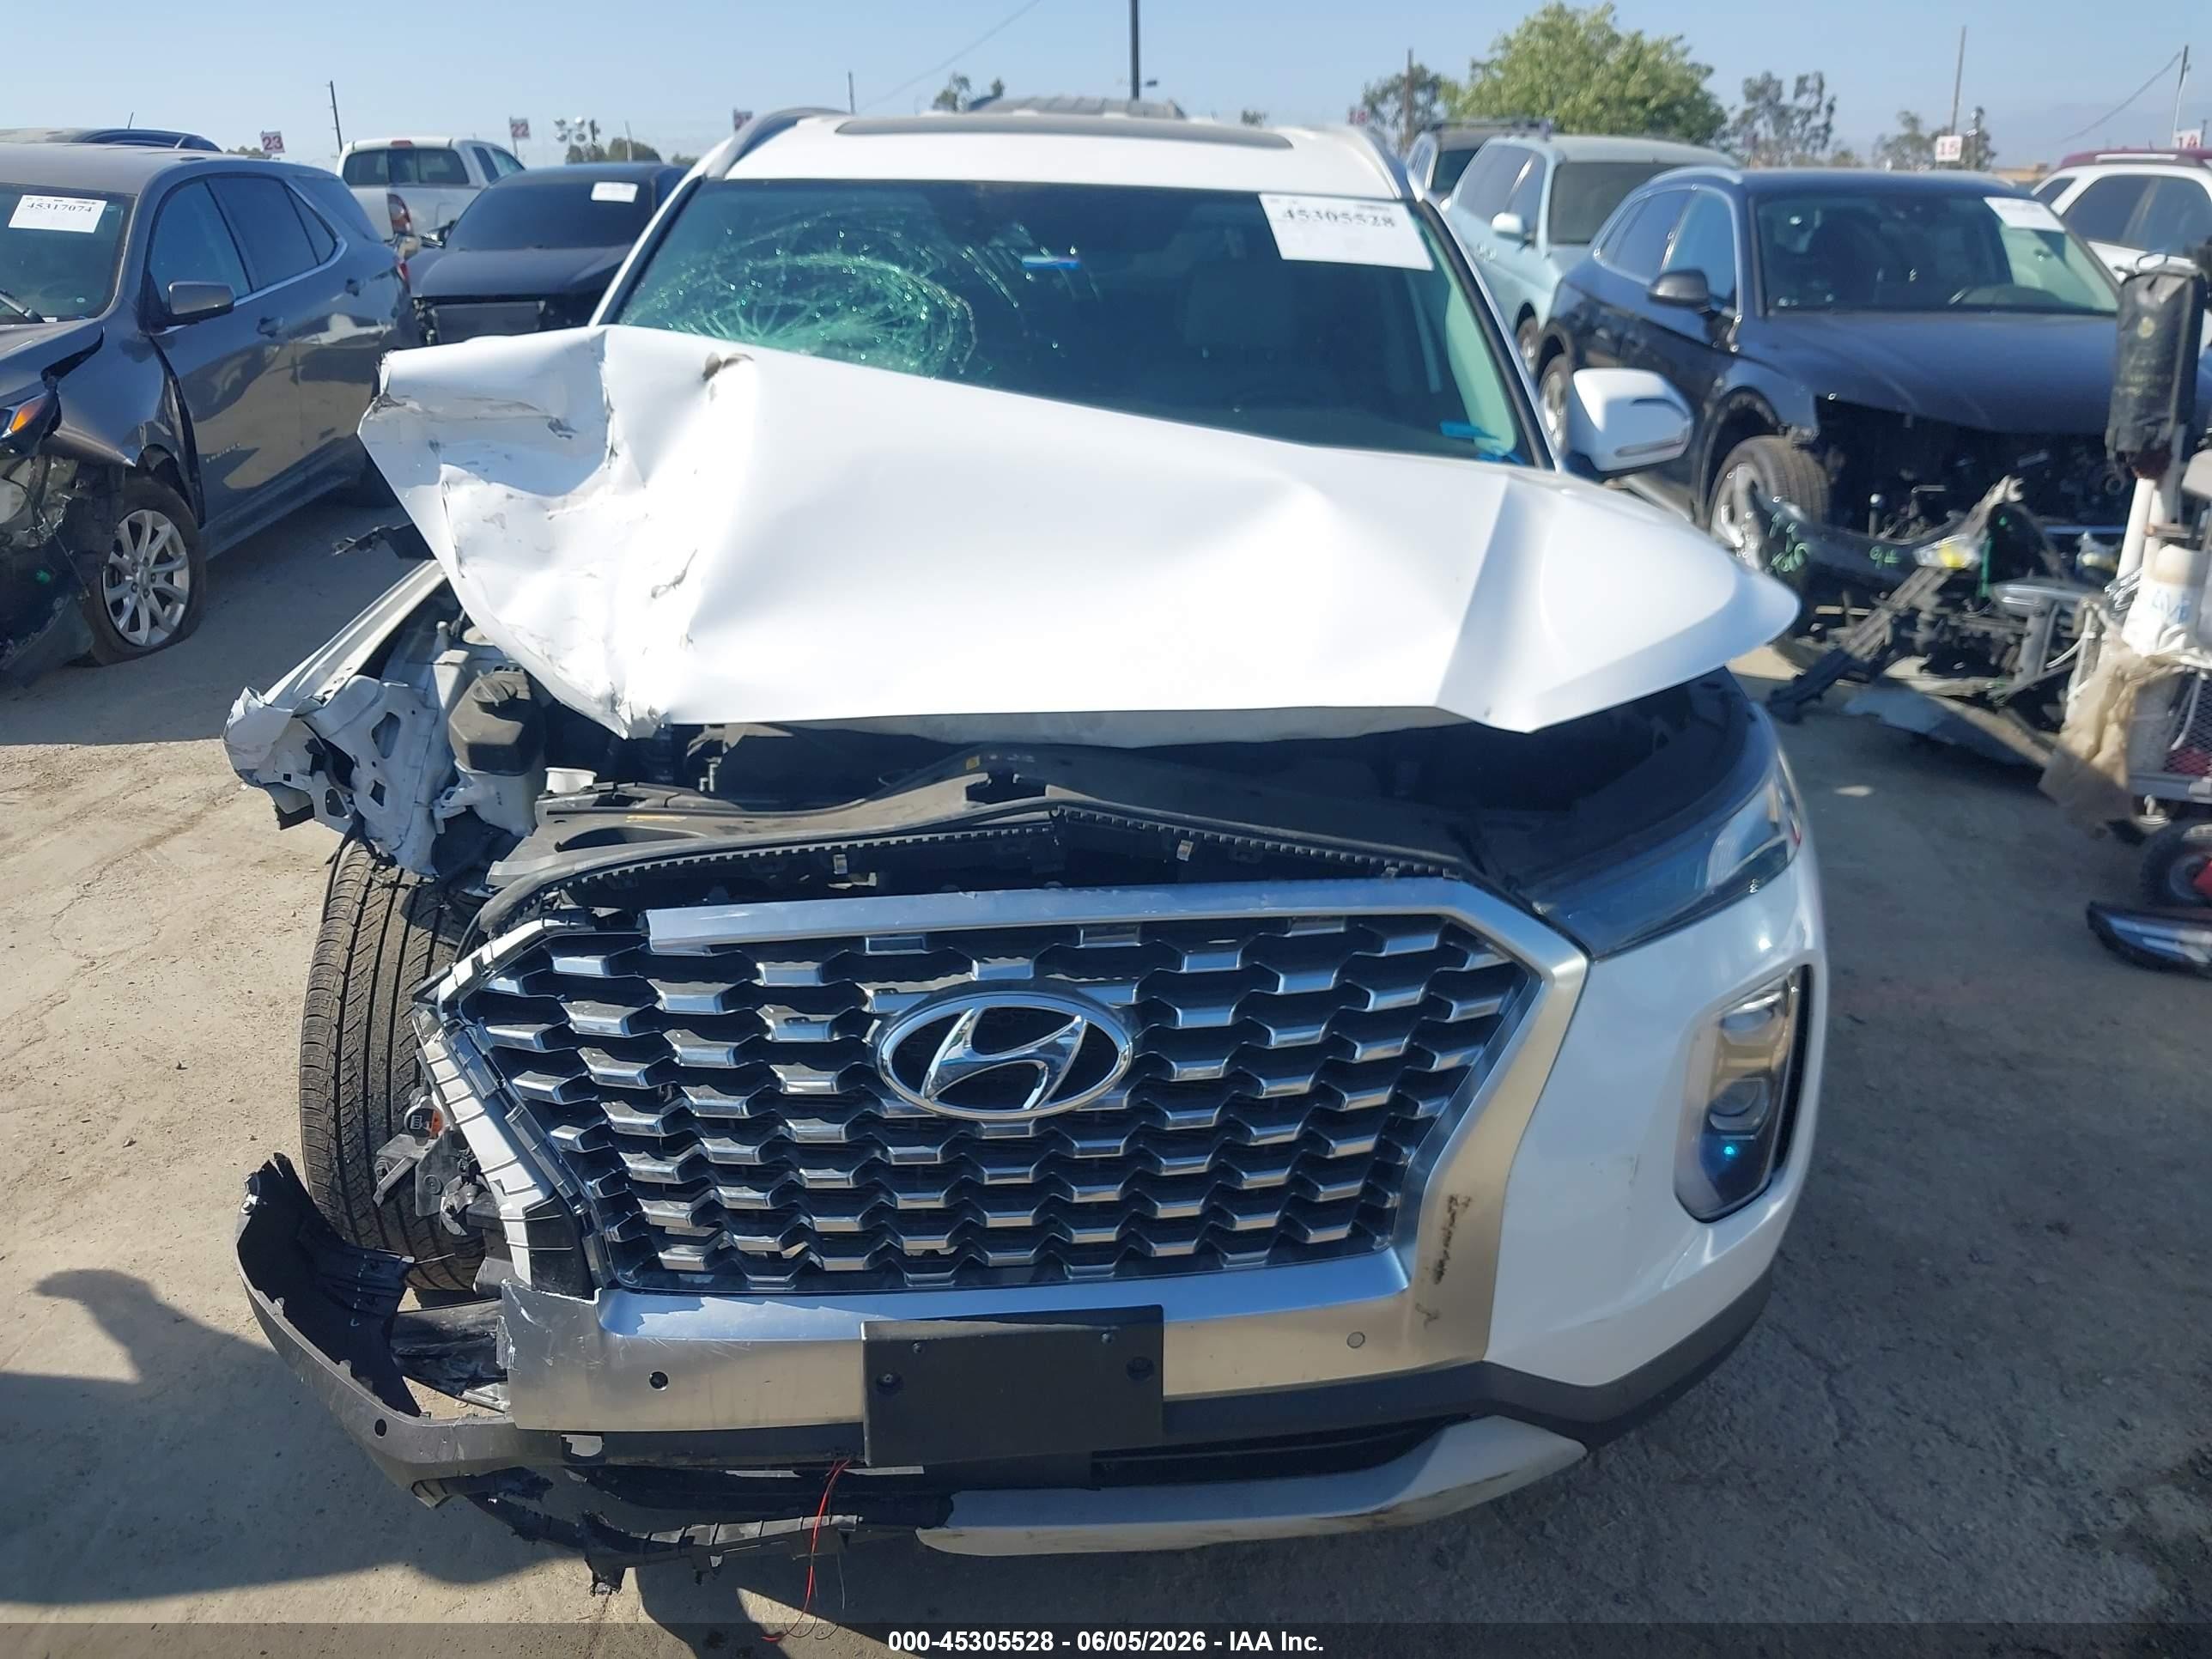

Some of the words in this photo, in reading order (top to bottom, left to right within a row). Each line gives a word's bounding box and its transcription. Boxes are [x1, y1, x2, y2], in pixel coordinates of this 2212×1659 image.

[262, 136, 283, 150] 23
[27, 202, 93, 213] 45317074
[1284, 208, 1395, 228] 45305528
